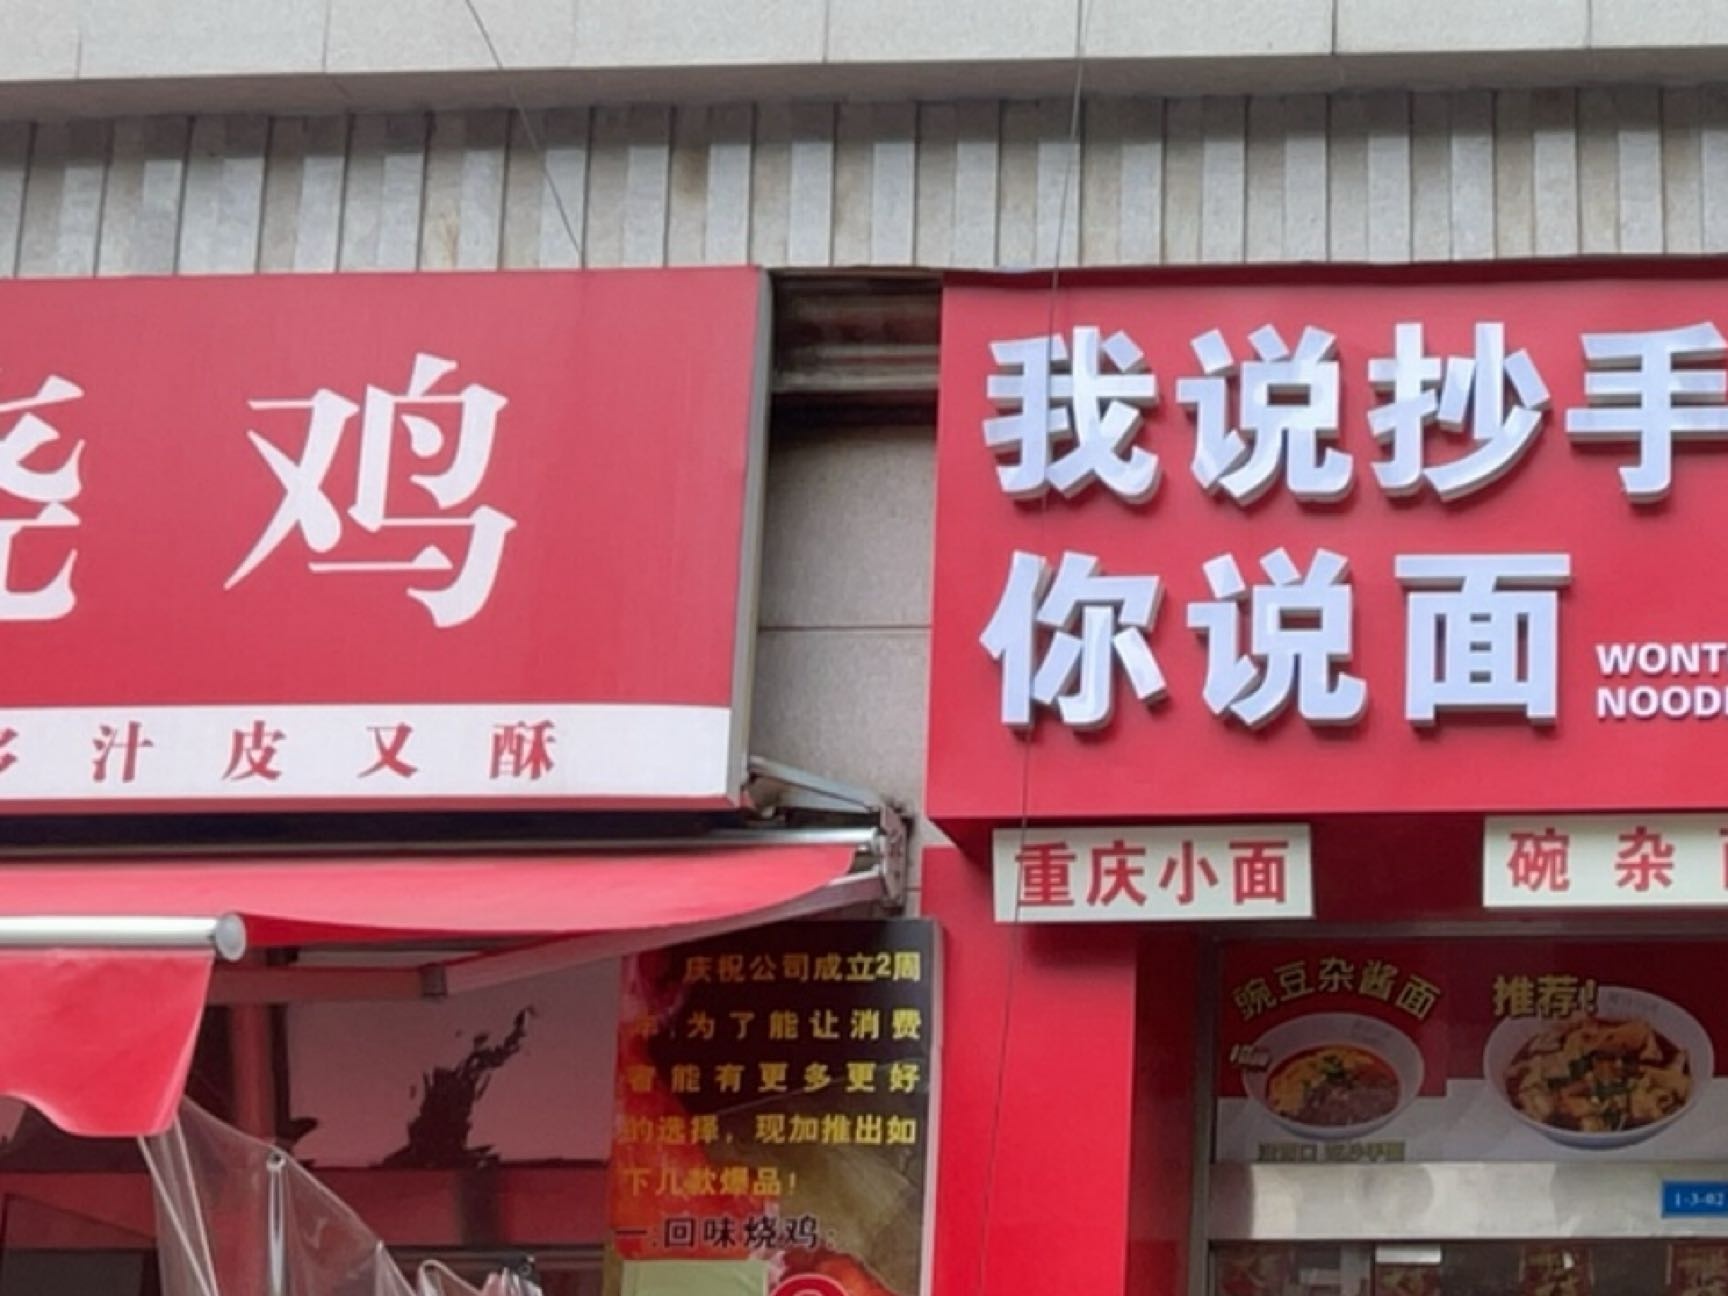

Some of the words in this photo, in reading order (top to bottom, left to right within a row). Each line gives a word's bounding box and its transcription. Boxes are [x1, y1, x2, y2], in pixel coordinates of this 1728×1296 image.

[979, 547, 1576, 733] 你说面
[0, 718, 558, 785] 汁皮又酥
[1014, 839, 1290, 910] 重庆小面
[684, 951, 922, 984] 庆祝公司成立2周
[626, 1061, 920, 1094] 者能有更多更好
[1673, 1191, 1726, 1208] 1-3-02
